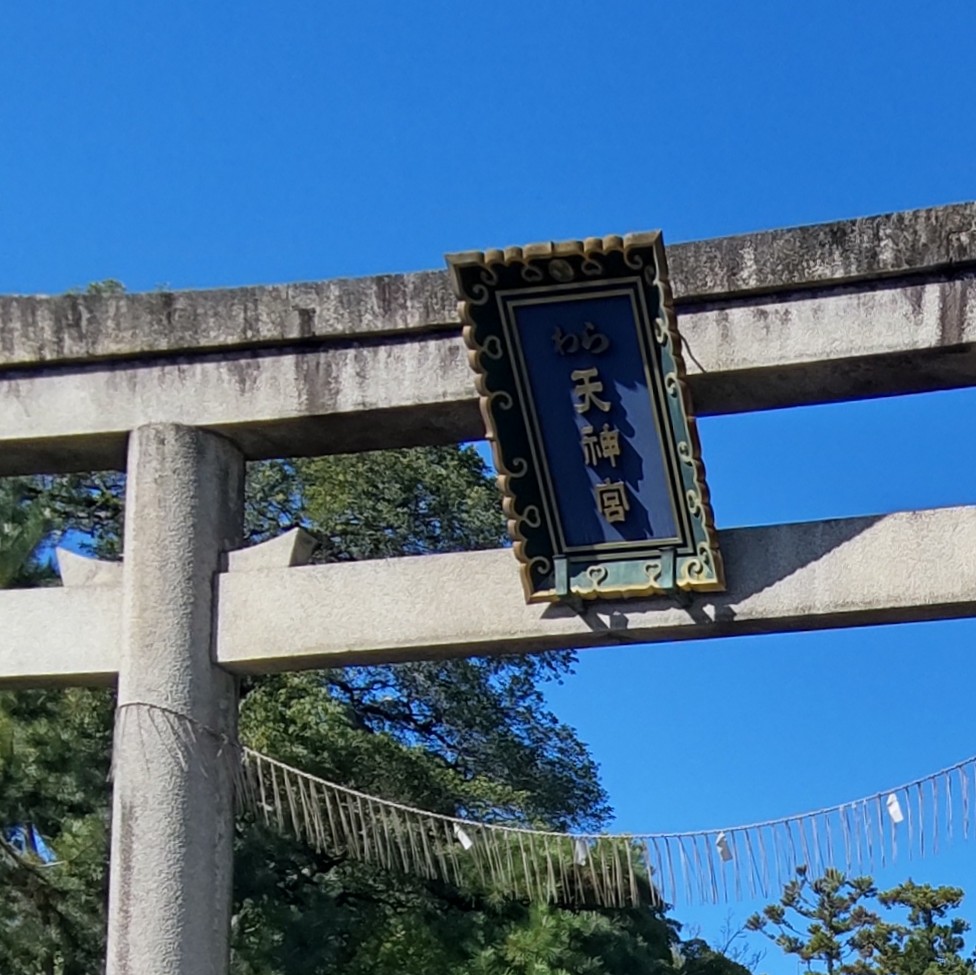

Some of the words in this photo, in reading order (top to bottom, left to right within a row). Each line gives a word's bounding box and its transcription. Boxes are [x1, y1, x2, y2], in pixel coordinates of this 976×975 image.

[552, 322, 609, 355] わら
[570, 367, 629, 523] 天神宮
